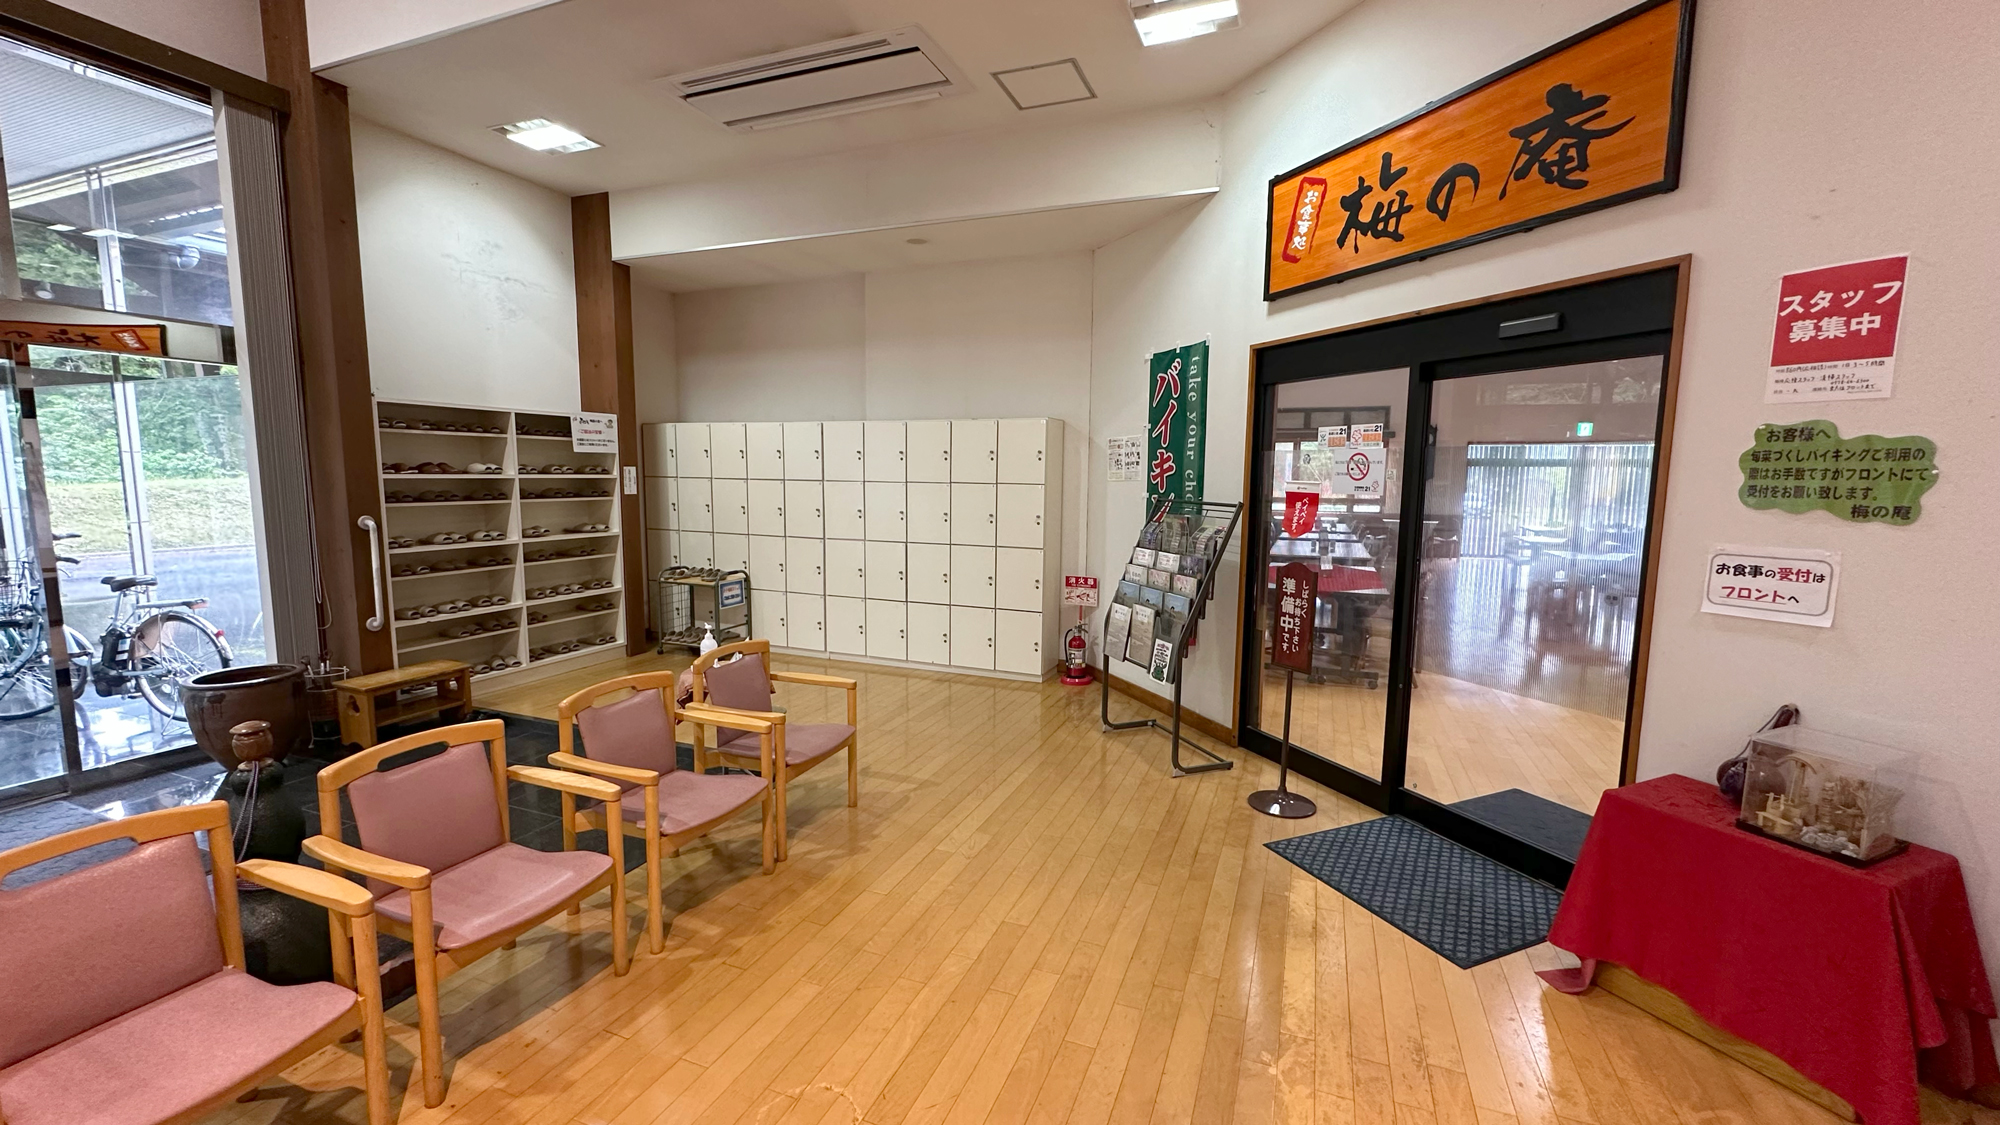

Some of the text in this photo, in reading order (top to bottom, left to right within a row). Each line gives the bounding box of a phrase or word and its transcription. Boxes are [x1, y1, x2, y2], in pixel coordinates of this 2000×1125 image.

[1336, 83, 1636, 253] 梅の庵
[1291, 189, 1318, 251] お食事処
[1779, 280, 1903, 316] スタッフ
[1789, 312, 1882, 344] 募集中
[1188, 356, 1202, 402] take
[1186, 410, 1198, 460] your
[1766, 427, 1832, 443] お客様へ
[1751, 448, 1926, 463] 旬菜づくしバイキングご利用の
[1748, 468, 1929, 482] 際はお手数ですがフロントにて
[1746, 484, 1878, 501] 受付をお願い致します。
[1850, 504, 1912, 520] 梅の庵
[1068, 577, 1094, 586] 消火器
[1715, 562, 1826, 584] お食事の受付は
[1301, 580, 1309, 618] しばらく
[1720, 584, 1800, 604] フロントへ
[1291, 598, 1302, 652] お待ち下さい
